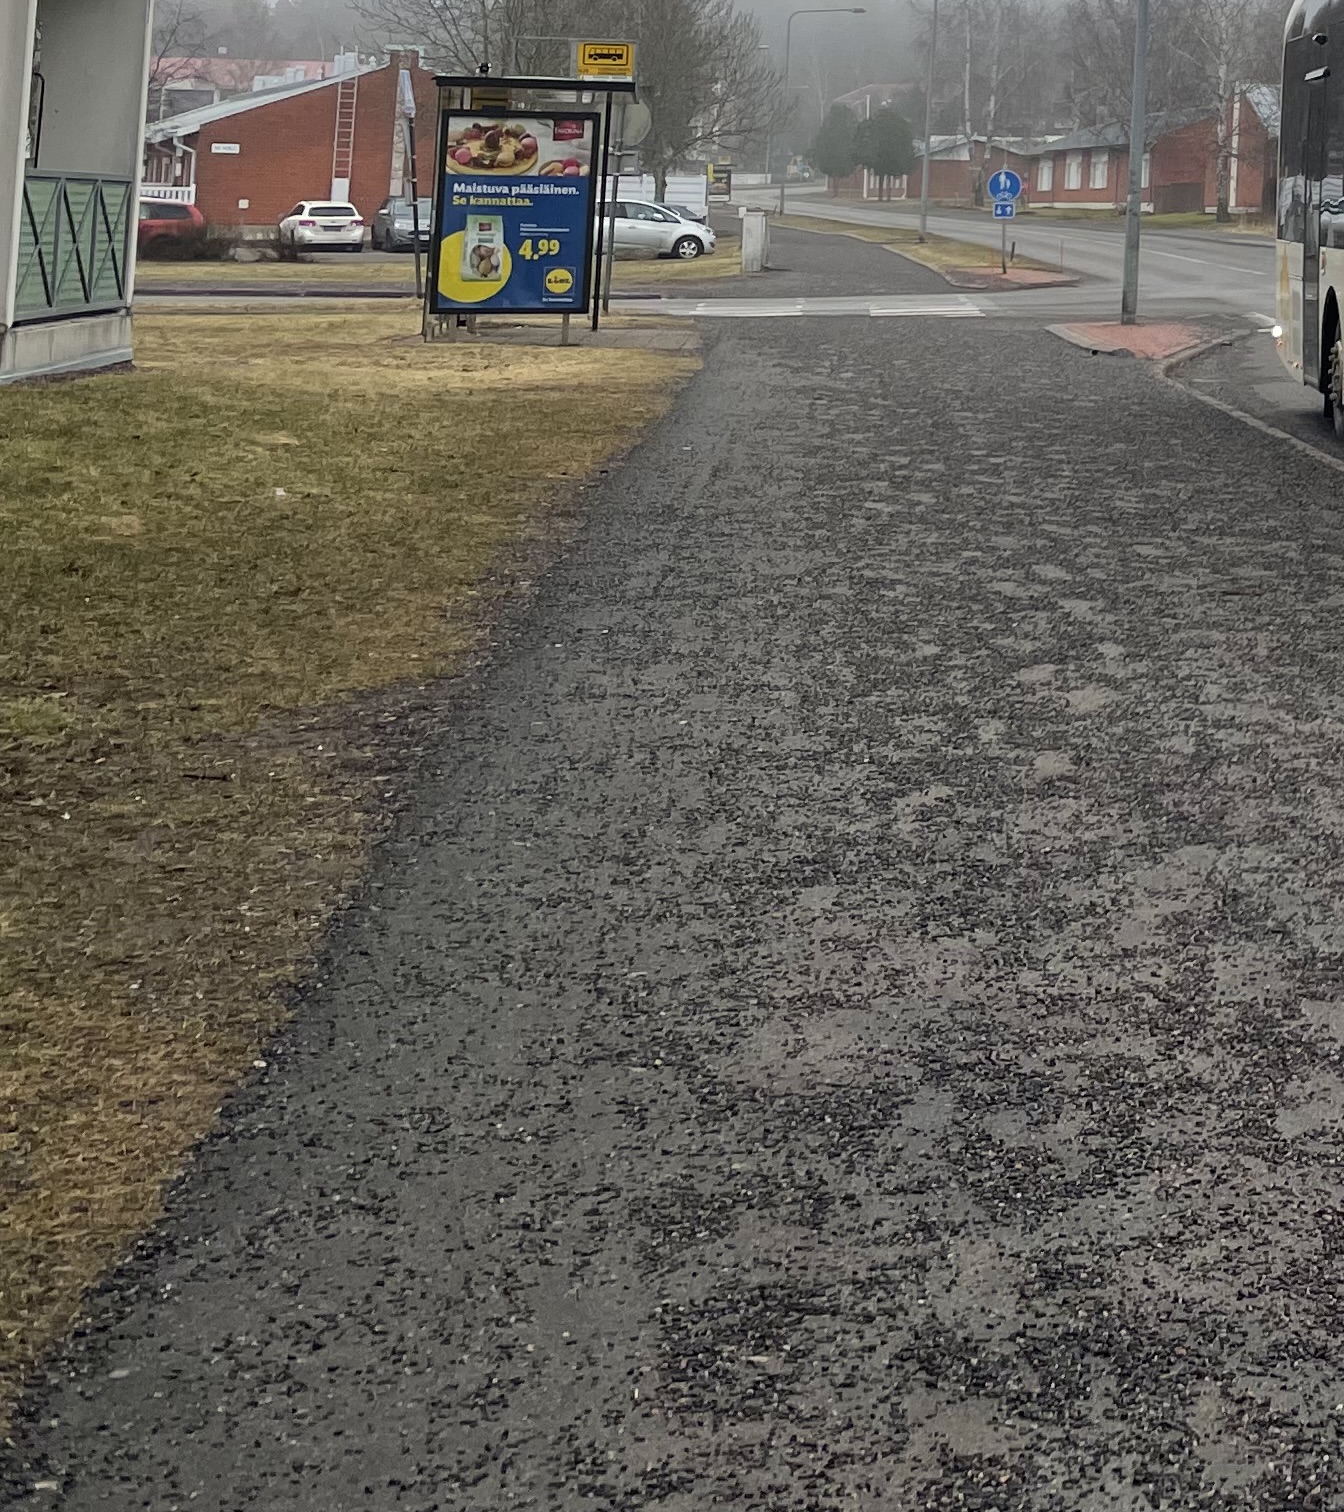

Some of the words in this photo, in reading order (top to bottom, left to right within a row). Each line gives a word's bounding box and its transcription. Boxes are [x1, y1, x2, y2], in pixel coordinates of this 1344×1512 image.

[453, 182, 509, 194] Maistuva
[511, 183, 580, 196] pääsiäinen.
[452, 195, 467, 205] Se
[469, 195, 534, 206] kannattaa.
[518, 239, 560, 260] 4.99
